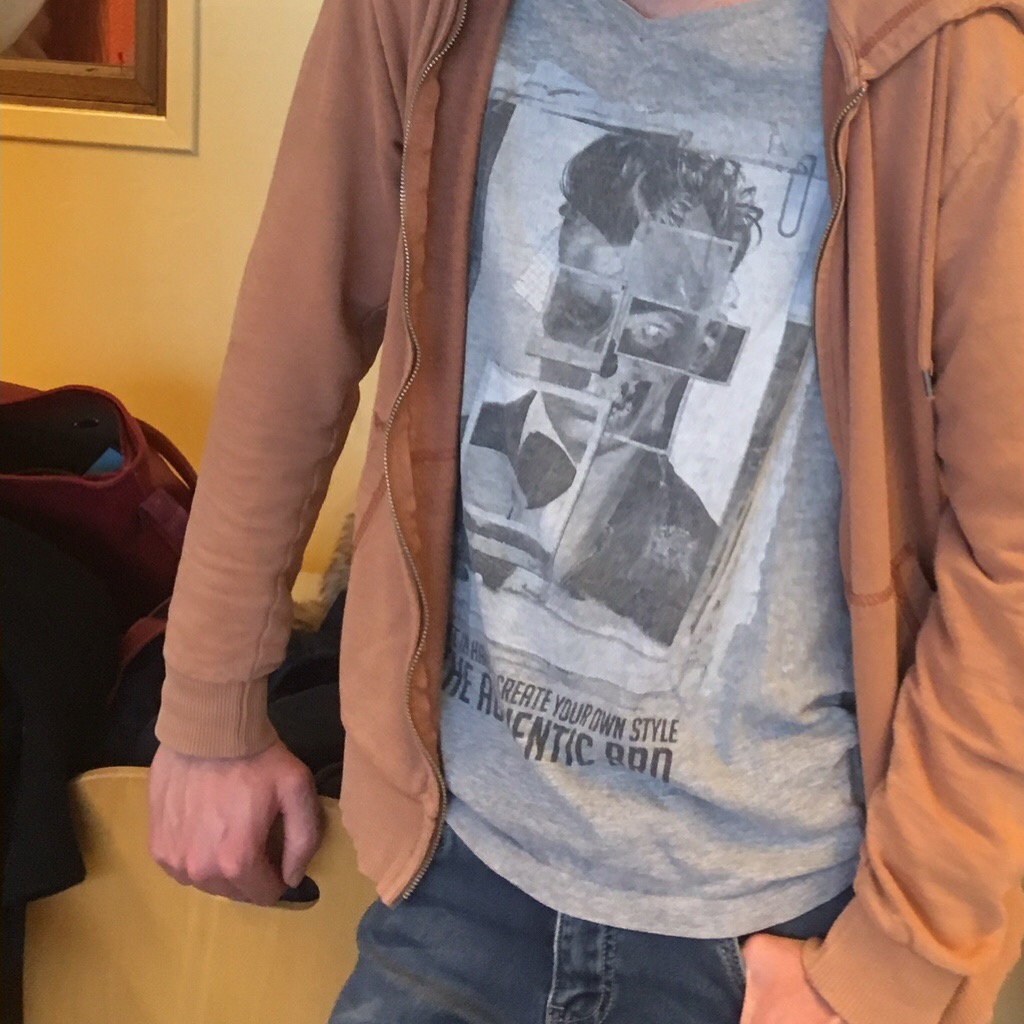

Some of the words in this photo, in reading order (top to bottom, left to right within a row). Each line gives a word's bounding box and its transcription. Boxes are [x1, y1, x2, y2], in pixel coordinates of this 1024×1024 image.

[496, 674, 554, 714] CREATE
[552, 693, 592, 725] YOUR
[588, 708, 627, 742] OWN
[628, 716, 680, 744] STYLE
